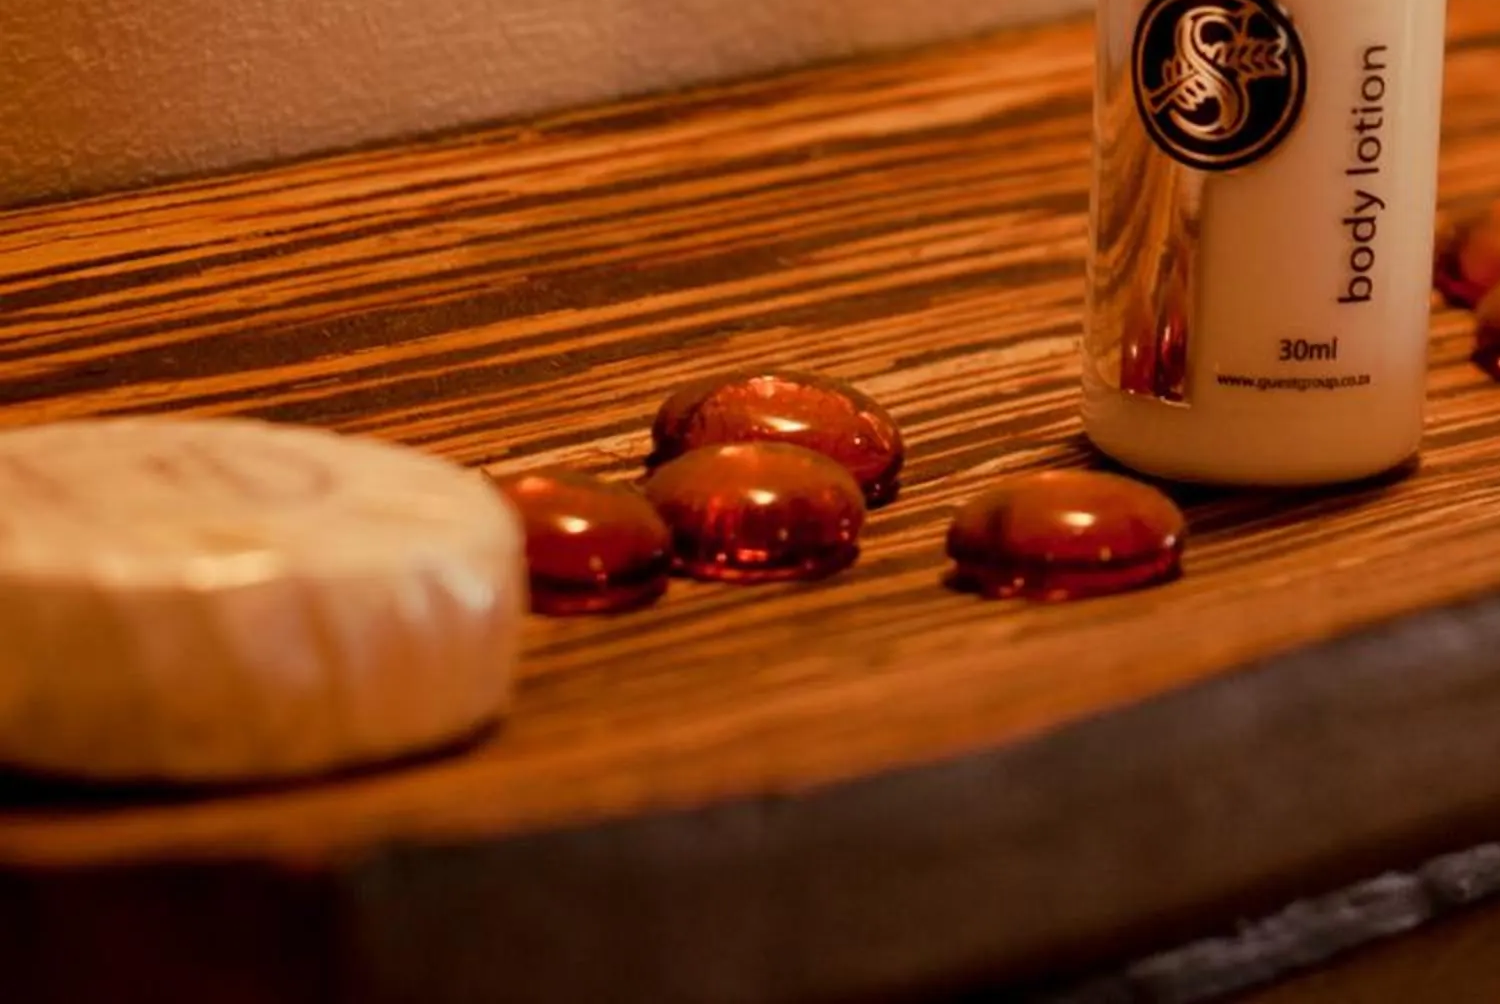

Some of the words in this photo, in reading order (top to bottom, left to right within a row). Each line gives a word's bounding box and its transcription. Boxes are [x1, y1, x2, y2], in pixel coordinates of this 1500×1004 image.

[1346, 45, 1388, 176] lotion
[1337, 189, 1386, 304] body
[1278, 336, 1339, 362] 30ml
